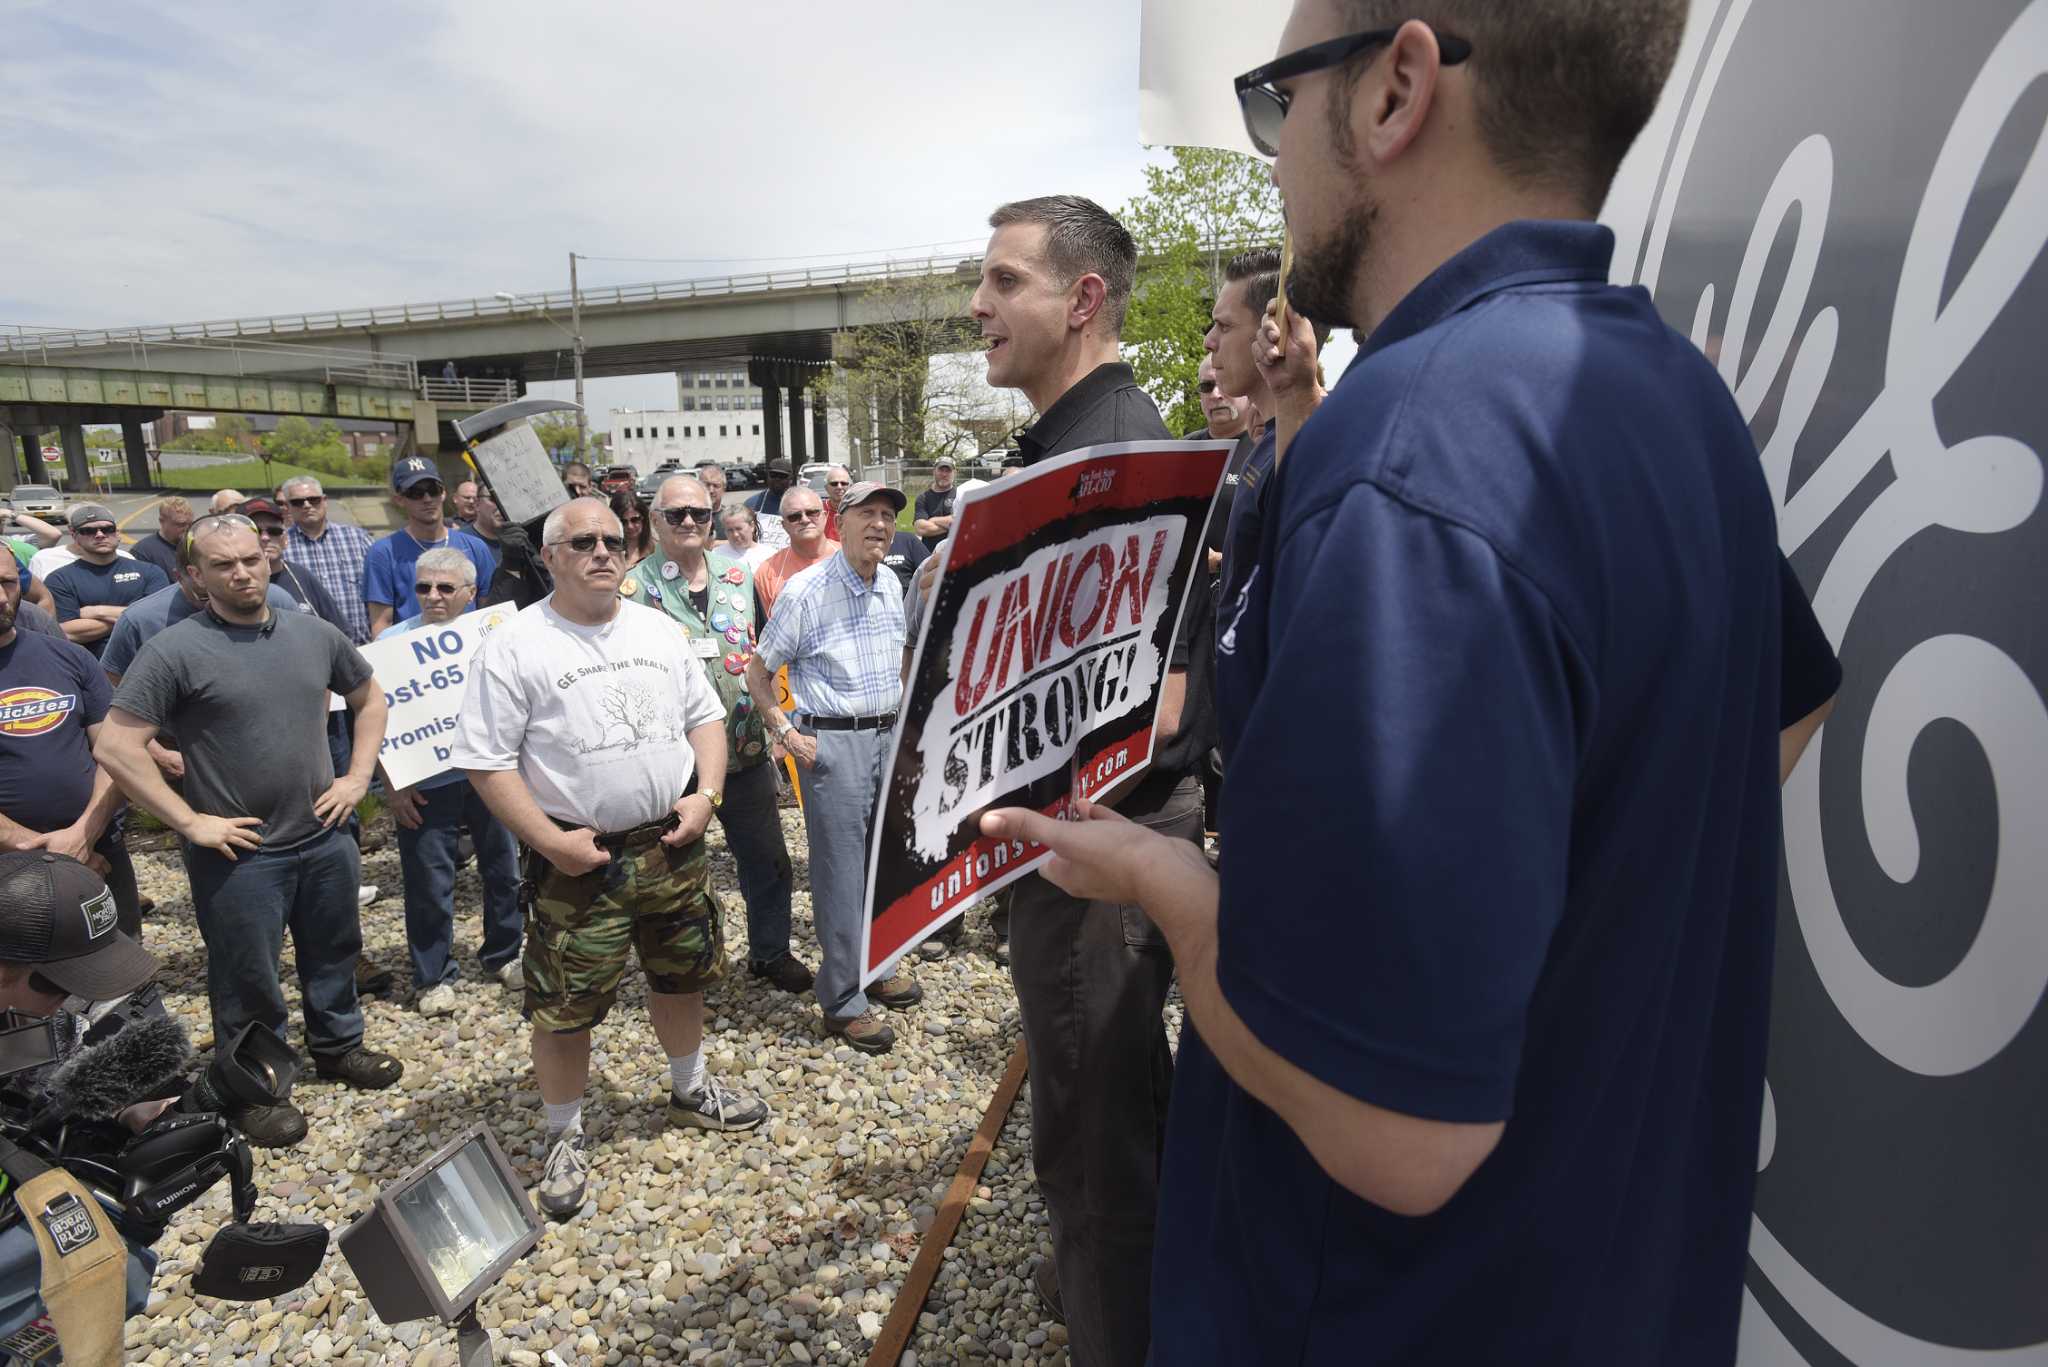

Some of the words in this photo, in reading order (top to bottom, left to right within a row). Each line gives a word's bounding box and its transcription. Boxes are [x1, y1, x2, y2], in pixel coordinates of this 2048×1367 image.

[954, 529, 1168, 717] UNION
[410, 630, 464, 665] NO
[384, 664, 464, 709] ost-65
[556, 672, 578, 690] GE
[0, 700, 69, 720] ickies
[380, 713, 460, 755] Promis
[938, 642, 1138, 815] STRONG!
[157, 1182, 197, 1209] FUJINON
[53, 1211, 85, 1235] brace
